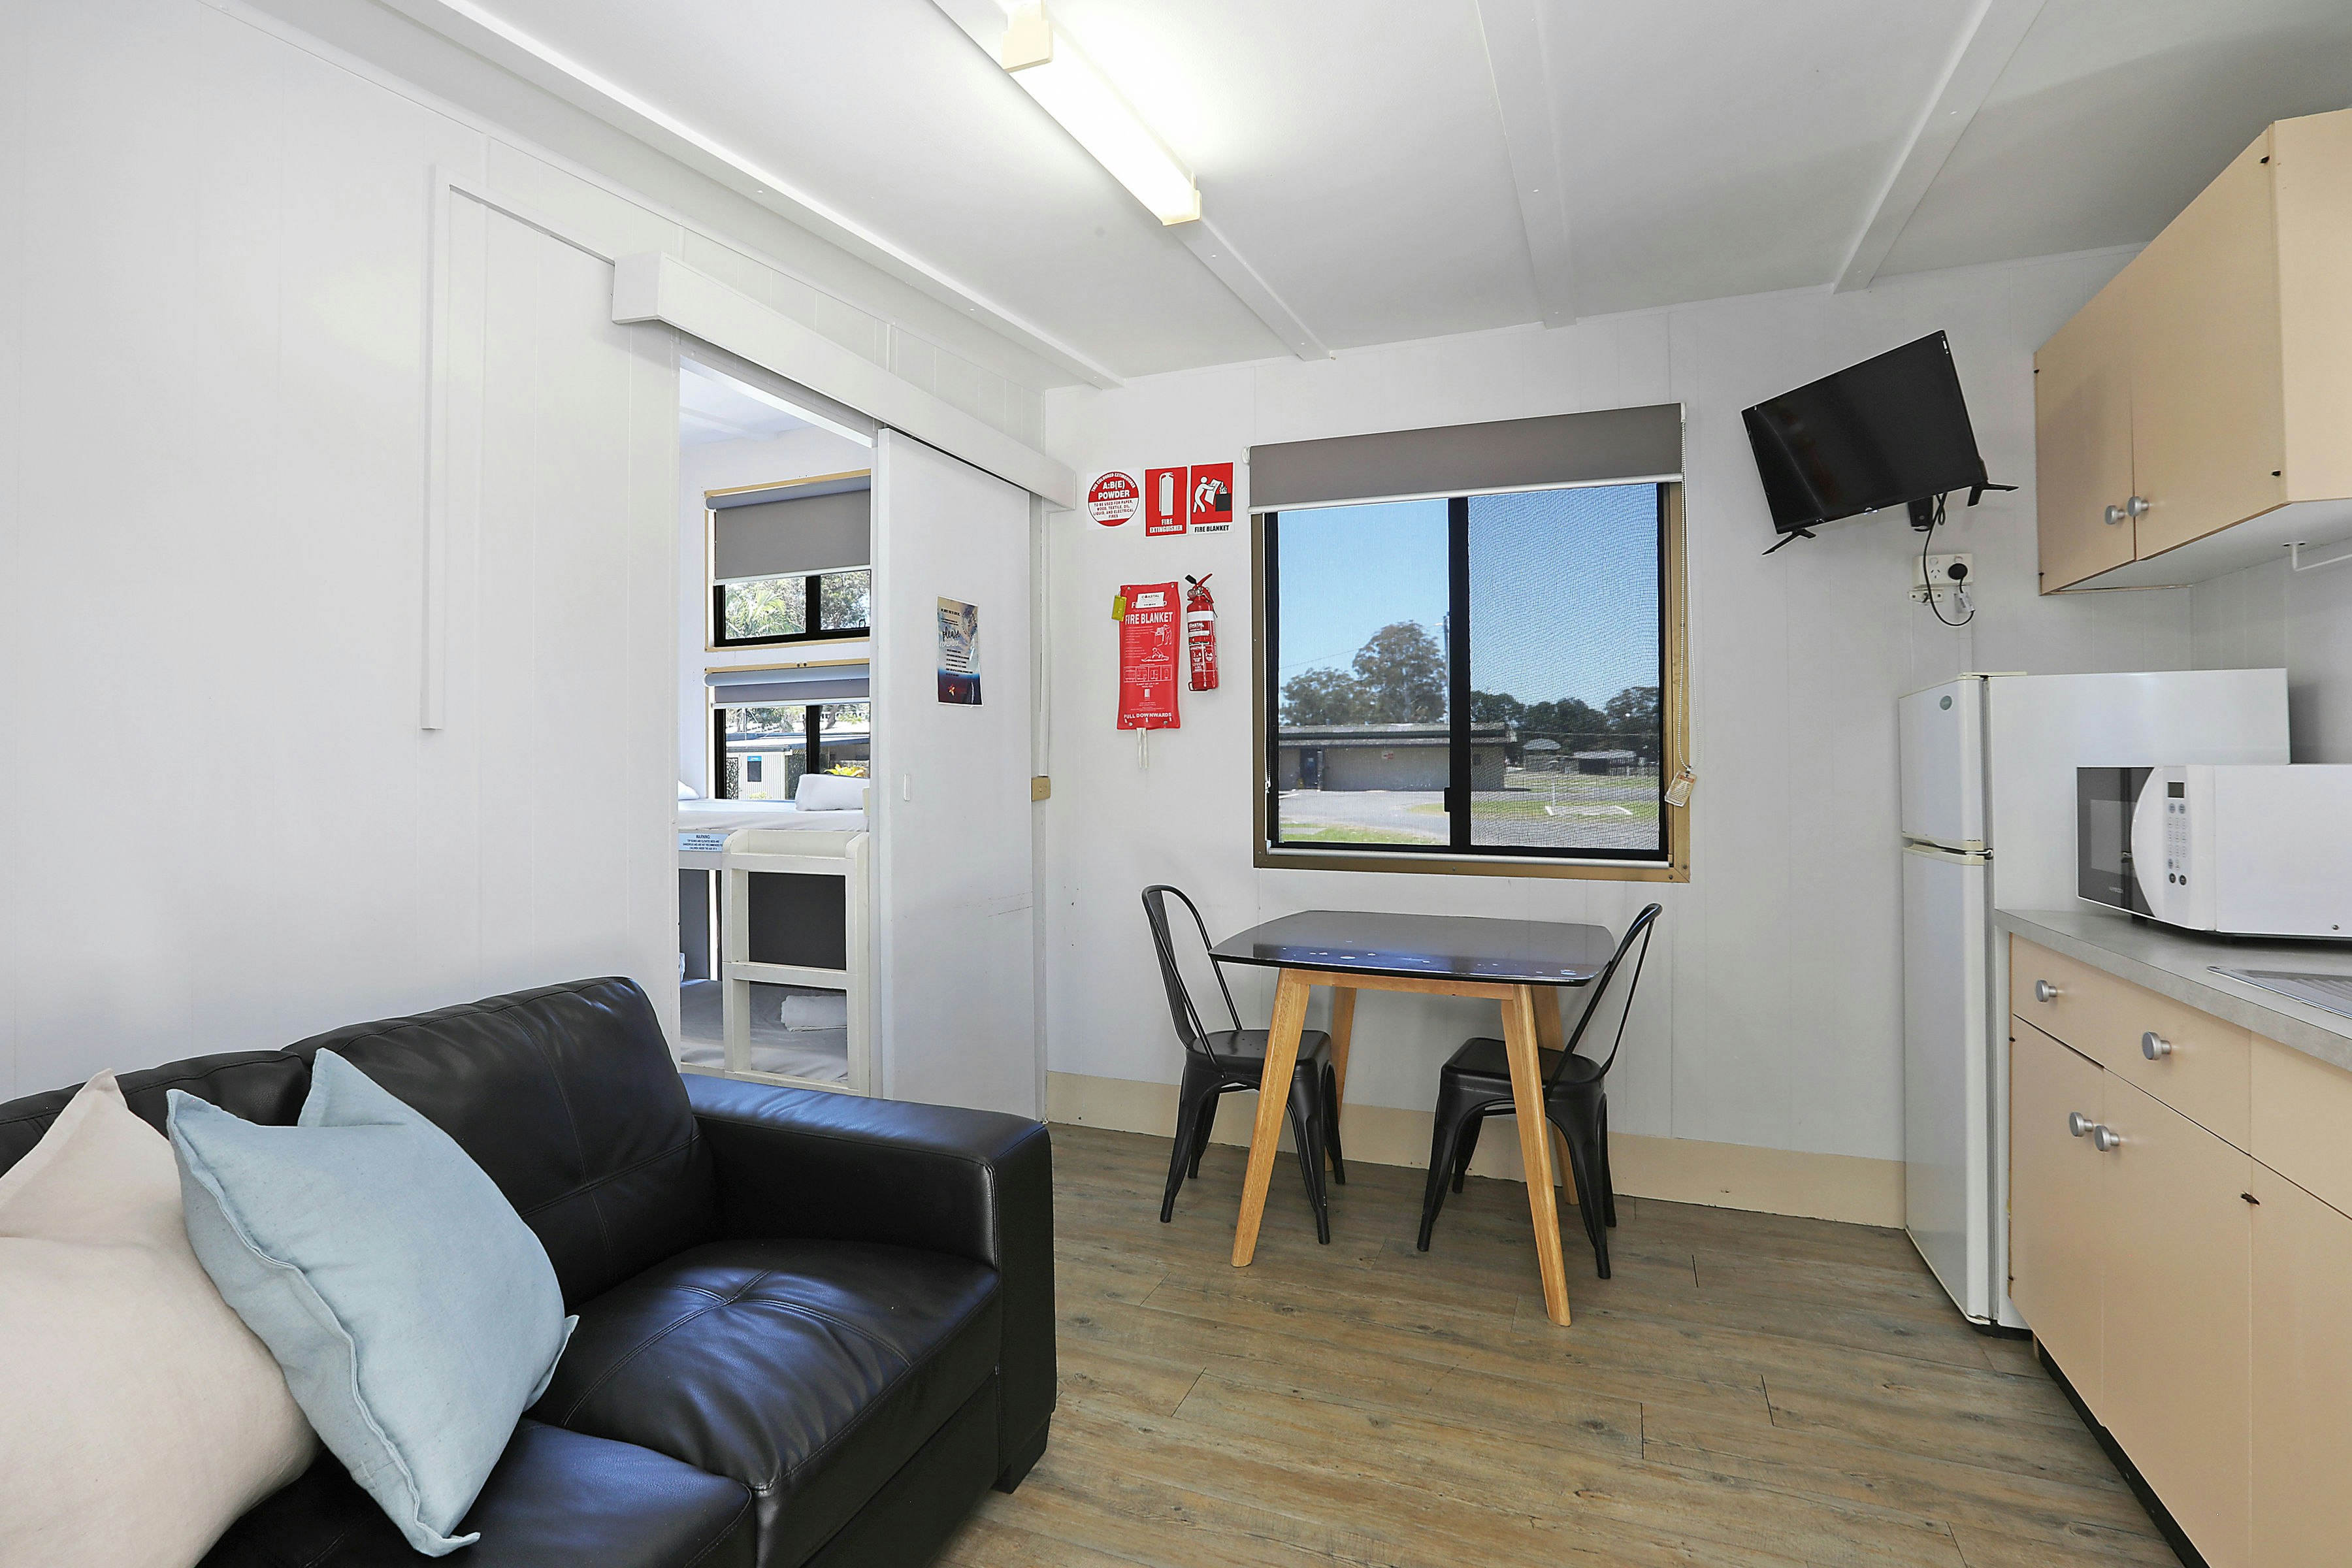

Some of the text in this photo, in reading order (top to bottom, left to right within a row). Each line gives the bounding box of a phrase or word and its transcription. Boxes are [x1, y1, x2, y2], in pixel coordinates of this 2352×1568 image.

[1102, 480, 1125, 489] A:B(E)
[1098, 490, 1130, 500] POWDER
[1149, 525, 1183, 533] EXTINGUISHER
[1125, 612, 1173, 625] FIRE BLANKET
